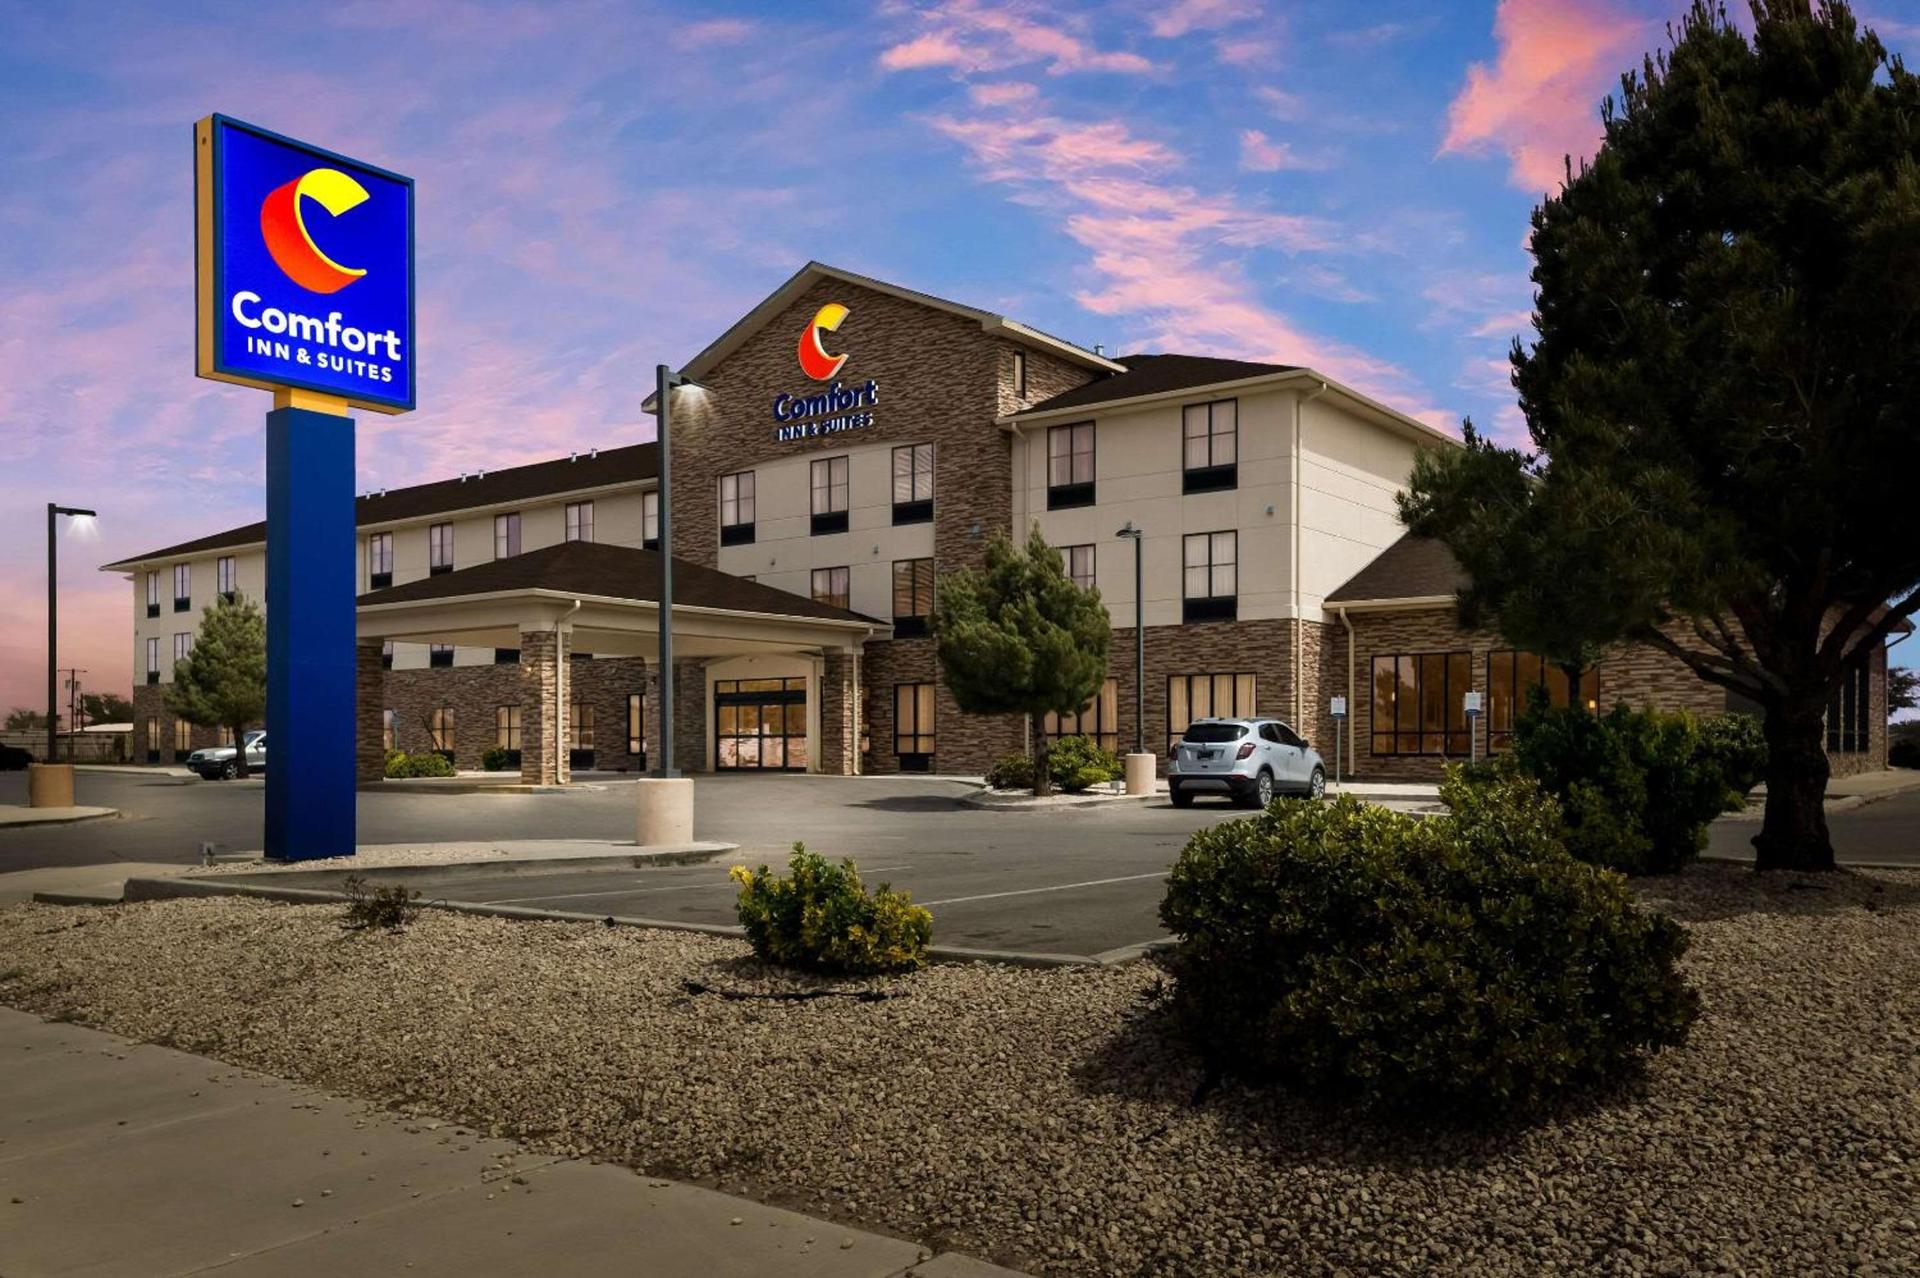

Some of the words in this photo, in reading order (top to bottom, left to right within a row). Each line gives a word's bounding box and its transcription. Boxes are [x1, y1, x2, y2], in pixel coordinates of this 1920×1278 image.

[232, 291, 401, 361] Comfort
[247, 336, 290, 361] INN
[296, 347, 311, 366] &
[317, 352, 392, 383] SUITES
[773, 380, 879, 421] Comfort
[778, 424, 806, 441] INN
[808, 422, 818, 436] &
[820, 412, 874, 435] SUITES
